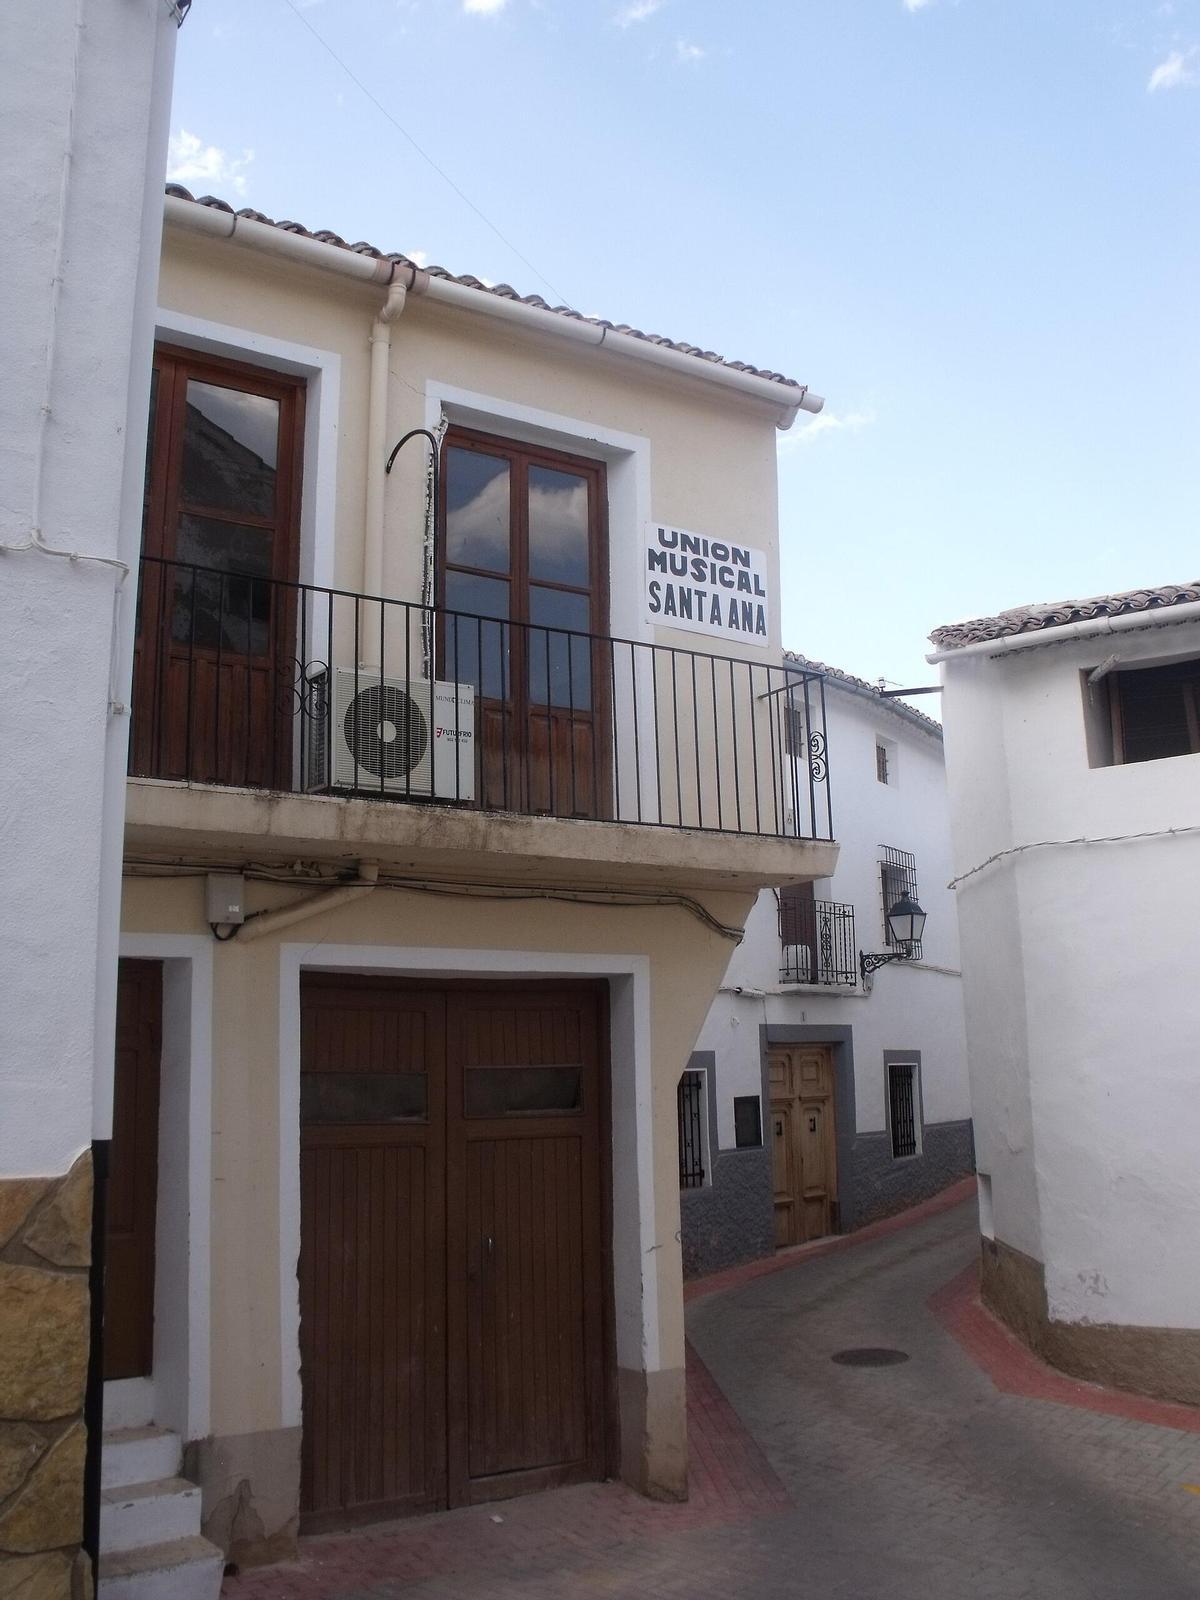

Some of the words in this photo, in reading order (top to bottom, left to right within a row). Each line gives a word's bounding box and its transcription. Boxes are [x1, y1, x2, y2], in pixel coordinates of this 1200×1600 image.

[648, 548, 766, 597] MUSICAL
[658, 528, 751, 568] UNION
[648, 581, 722, 626] SANTA
[728, 598, 767, 636] ANA
